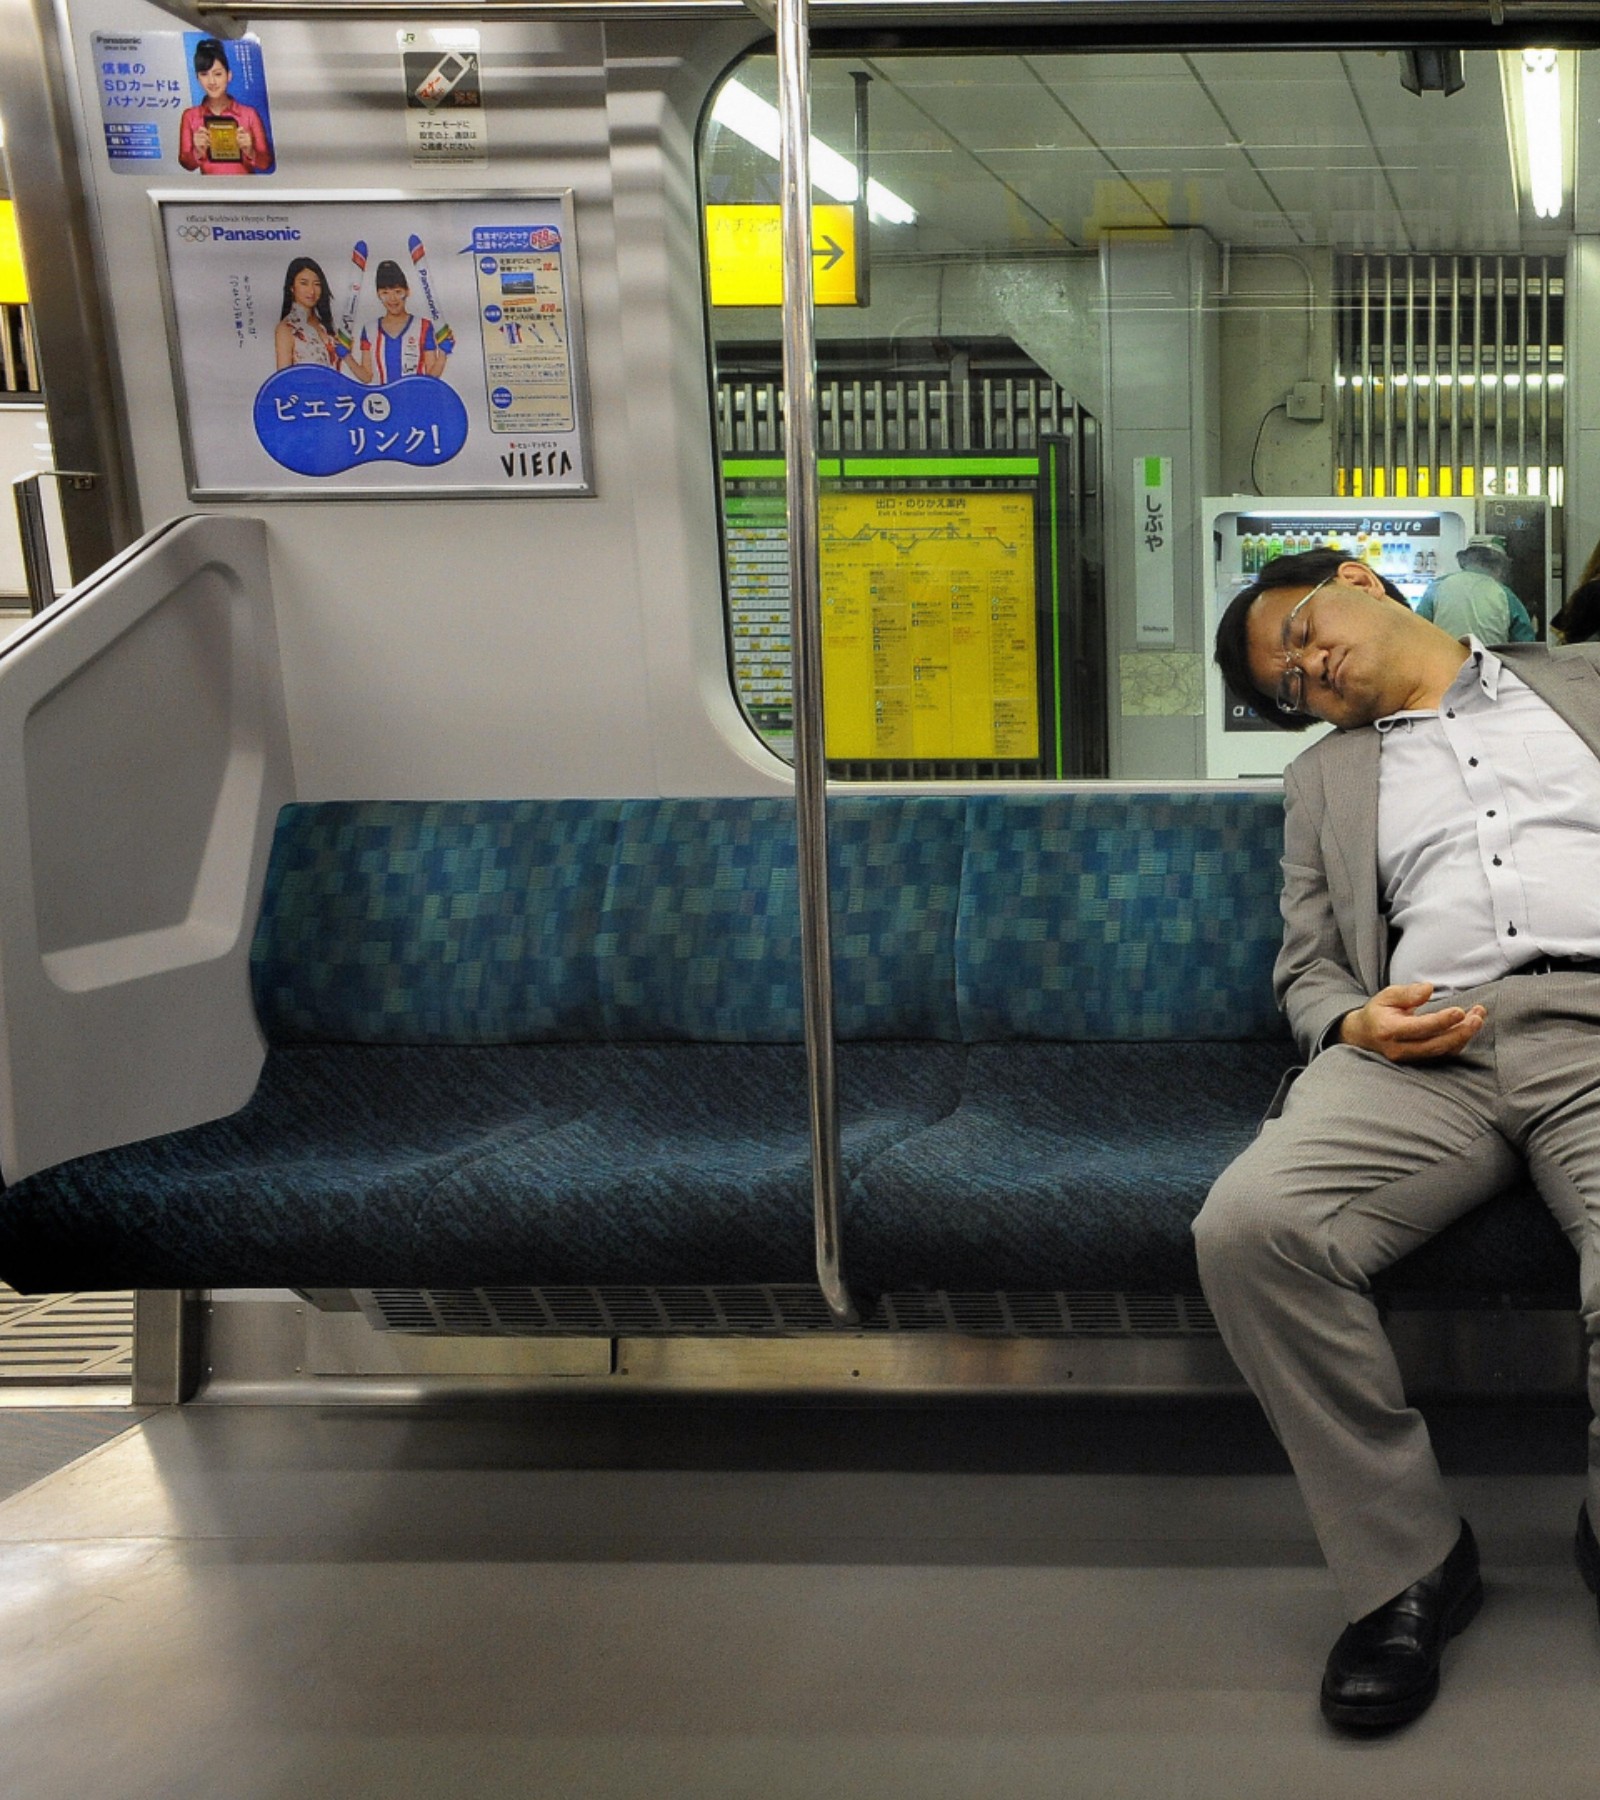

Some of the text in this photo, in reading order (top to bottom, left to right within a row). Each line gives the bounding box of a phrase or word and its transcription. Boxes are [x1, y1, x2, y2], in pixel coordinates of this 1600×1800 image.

[96, 36, 142, 45] Panasonic
[102, 63, 145, 75] 信頼の
[104, 80, 180, 92] SDカードは
[107, 97, 181, 108] パナソニック
[212, 226, 301, 241] Panasonic
[418, 268, 440, 321] Panasonic
[1145, 495, 1163, 552] しぶや
[1372, 520, 1422, 531] acure
